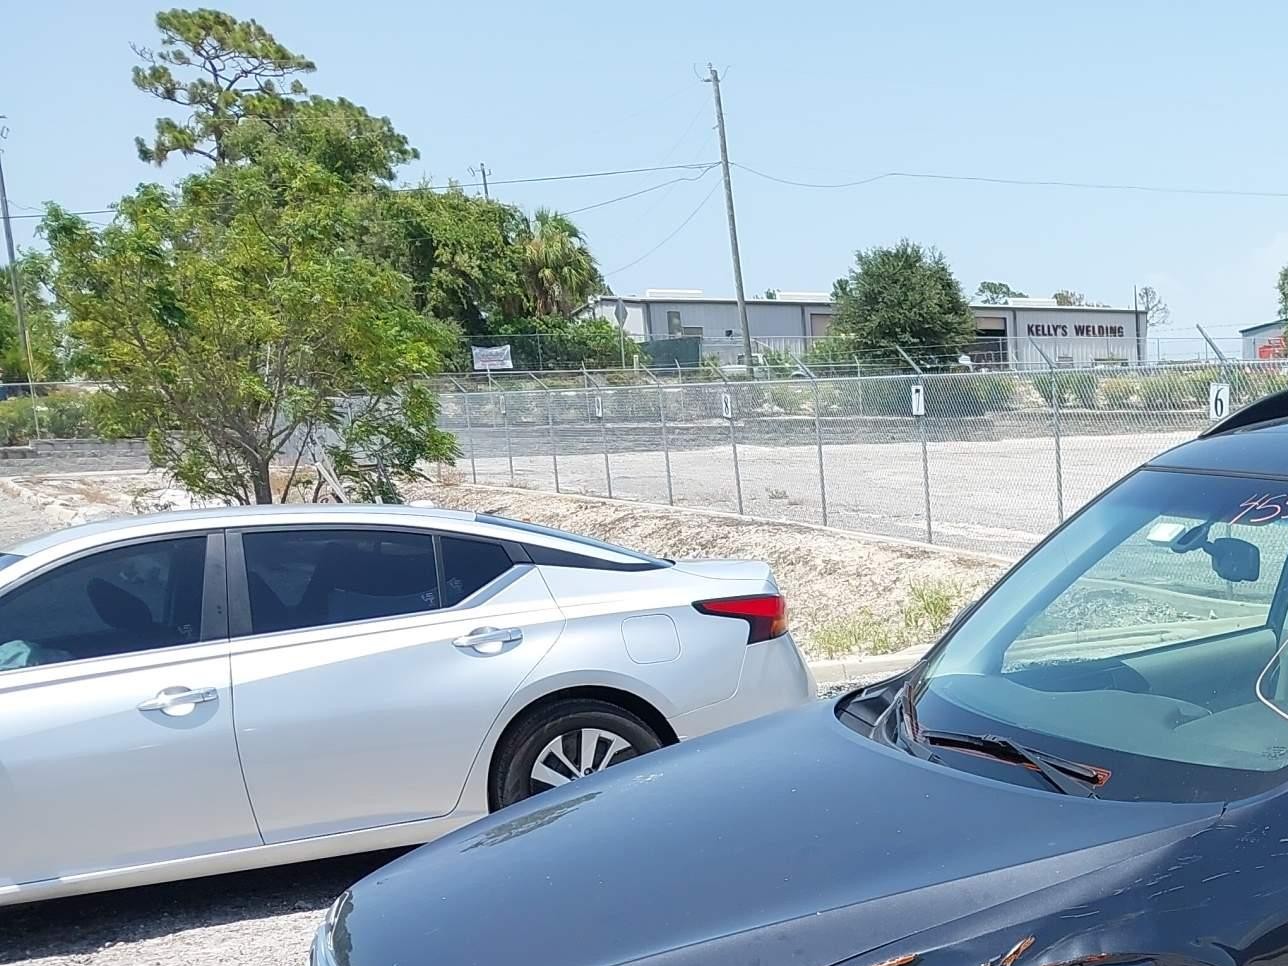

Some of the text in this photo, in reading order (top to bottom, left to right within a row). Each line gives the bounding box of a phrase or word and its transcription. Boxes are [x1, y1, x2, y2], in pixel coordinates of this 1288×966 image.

[1027, 323, 1125, 338] KELLY'S WELDING
[1214, 387, 1225, 418] 6
